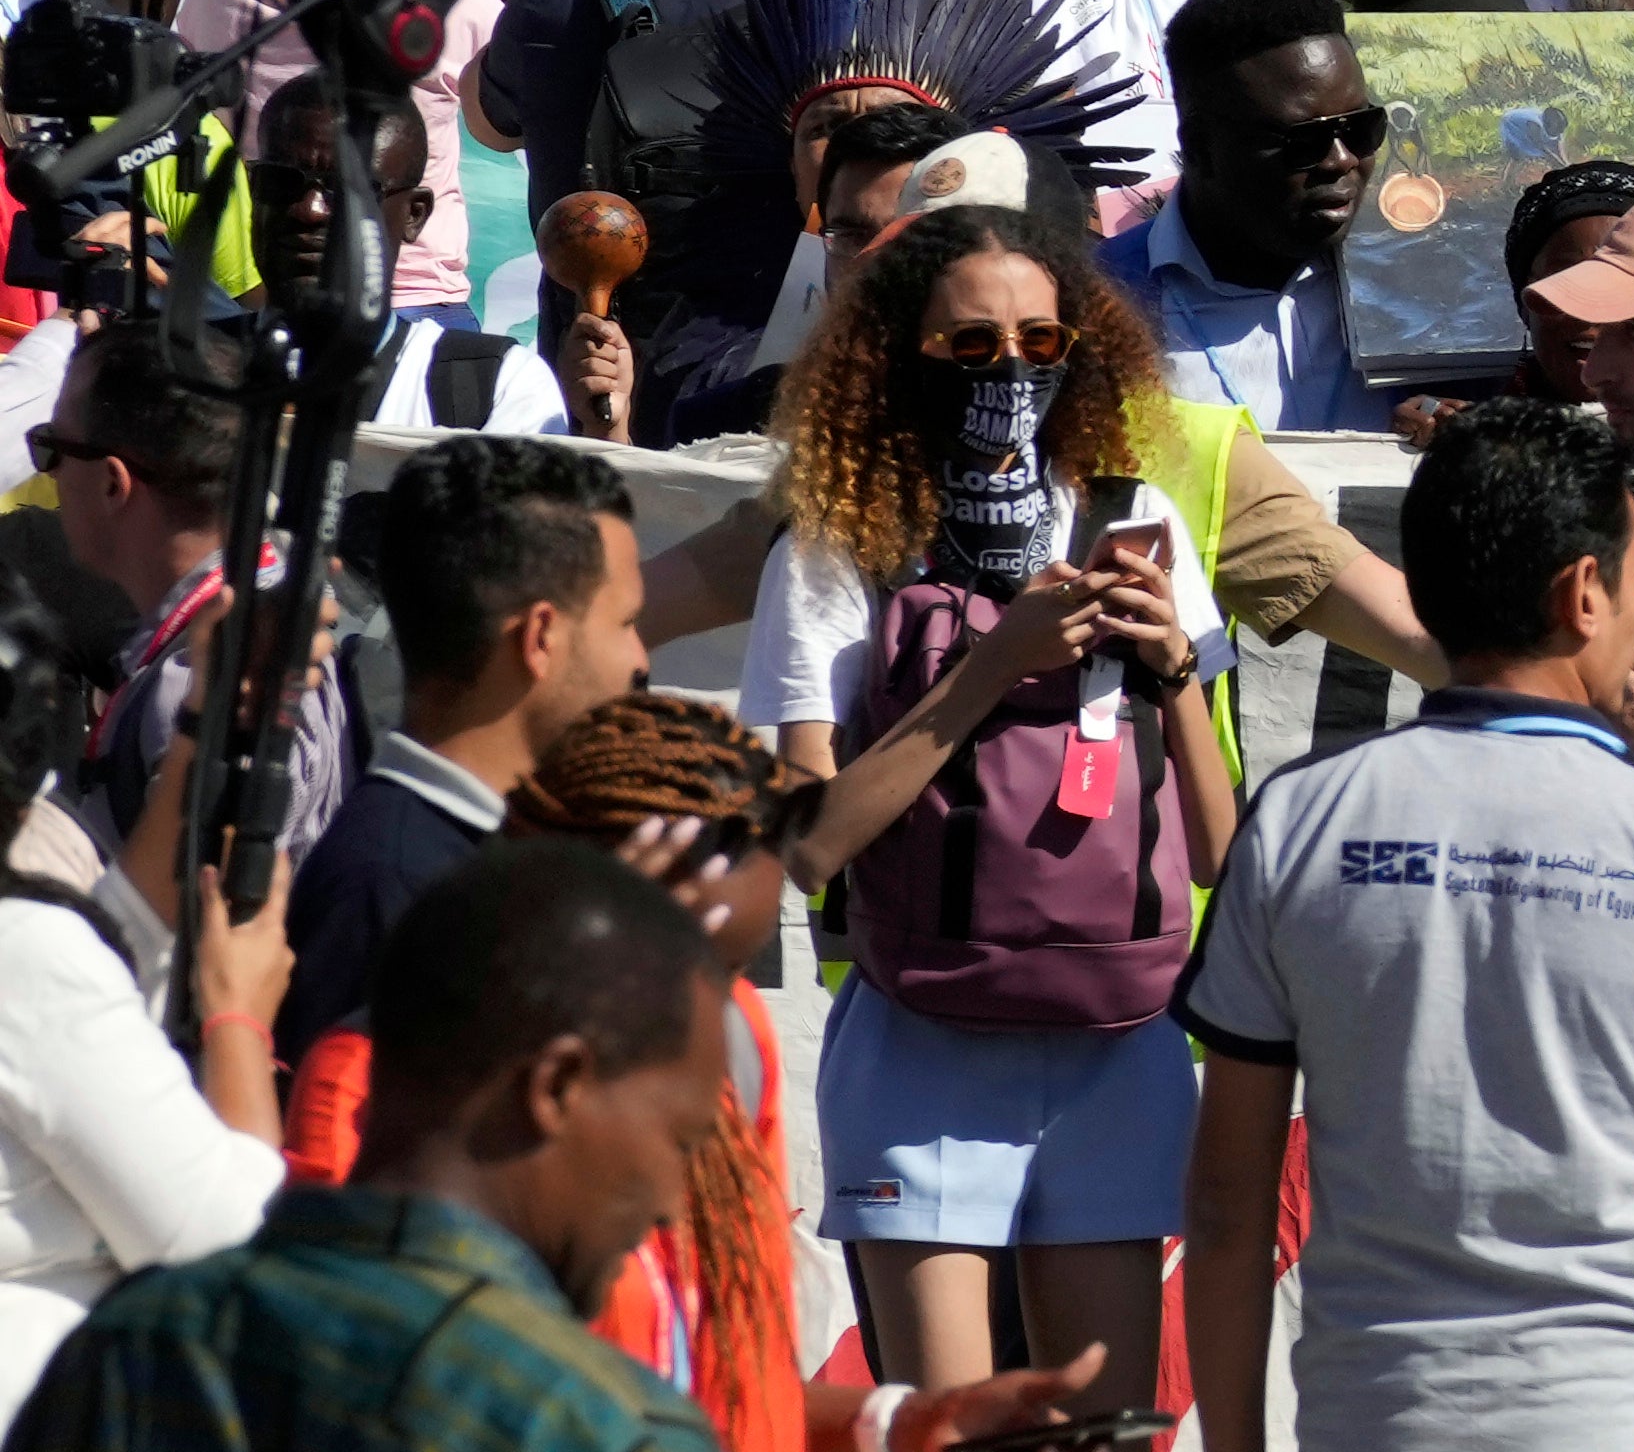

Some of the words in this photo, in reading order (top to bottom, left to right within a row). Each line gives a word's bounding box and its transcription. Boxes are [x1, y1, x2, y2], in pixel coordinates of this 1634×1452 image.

[117, 129, 178, 176] RONIN
[986, 555, 1023, 572] LRC
[1586, 888, 1602, 909] of
